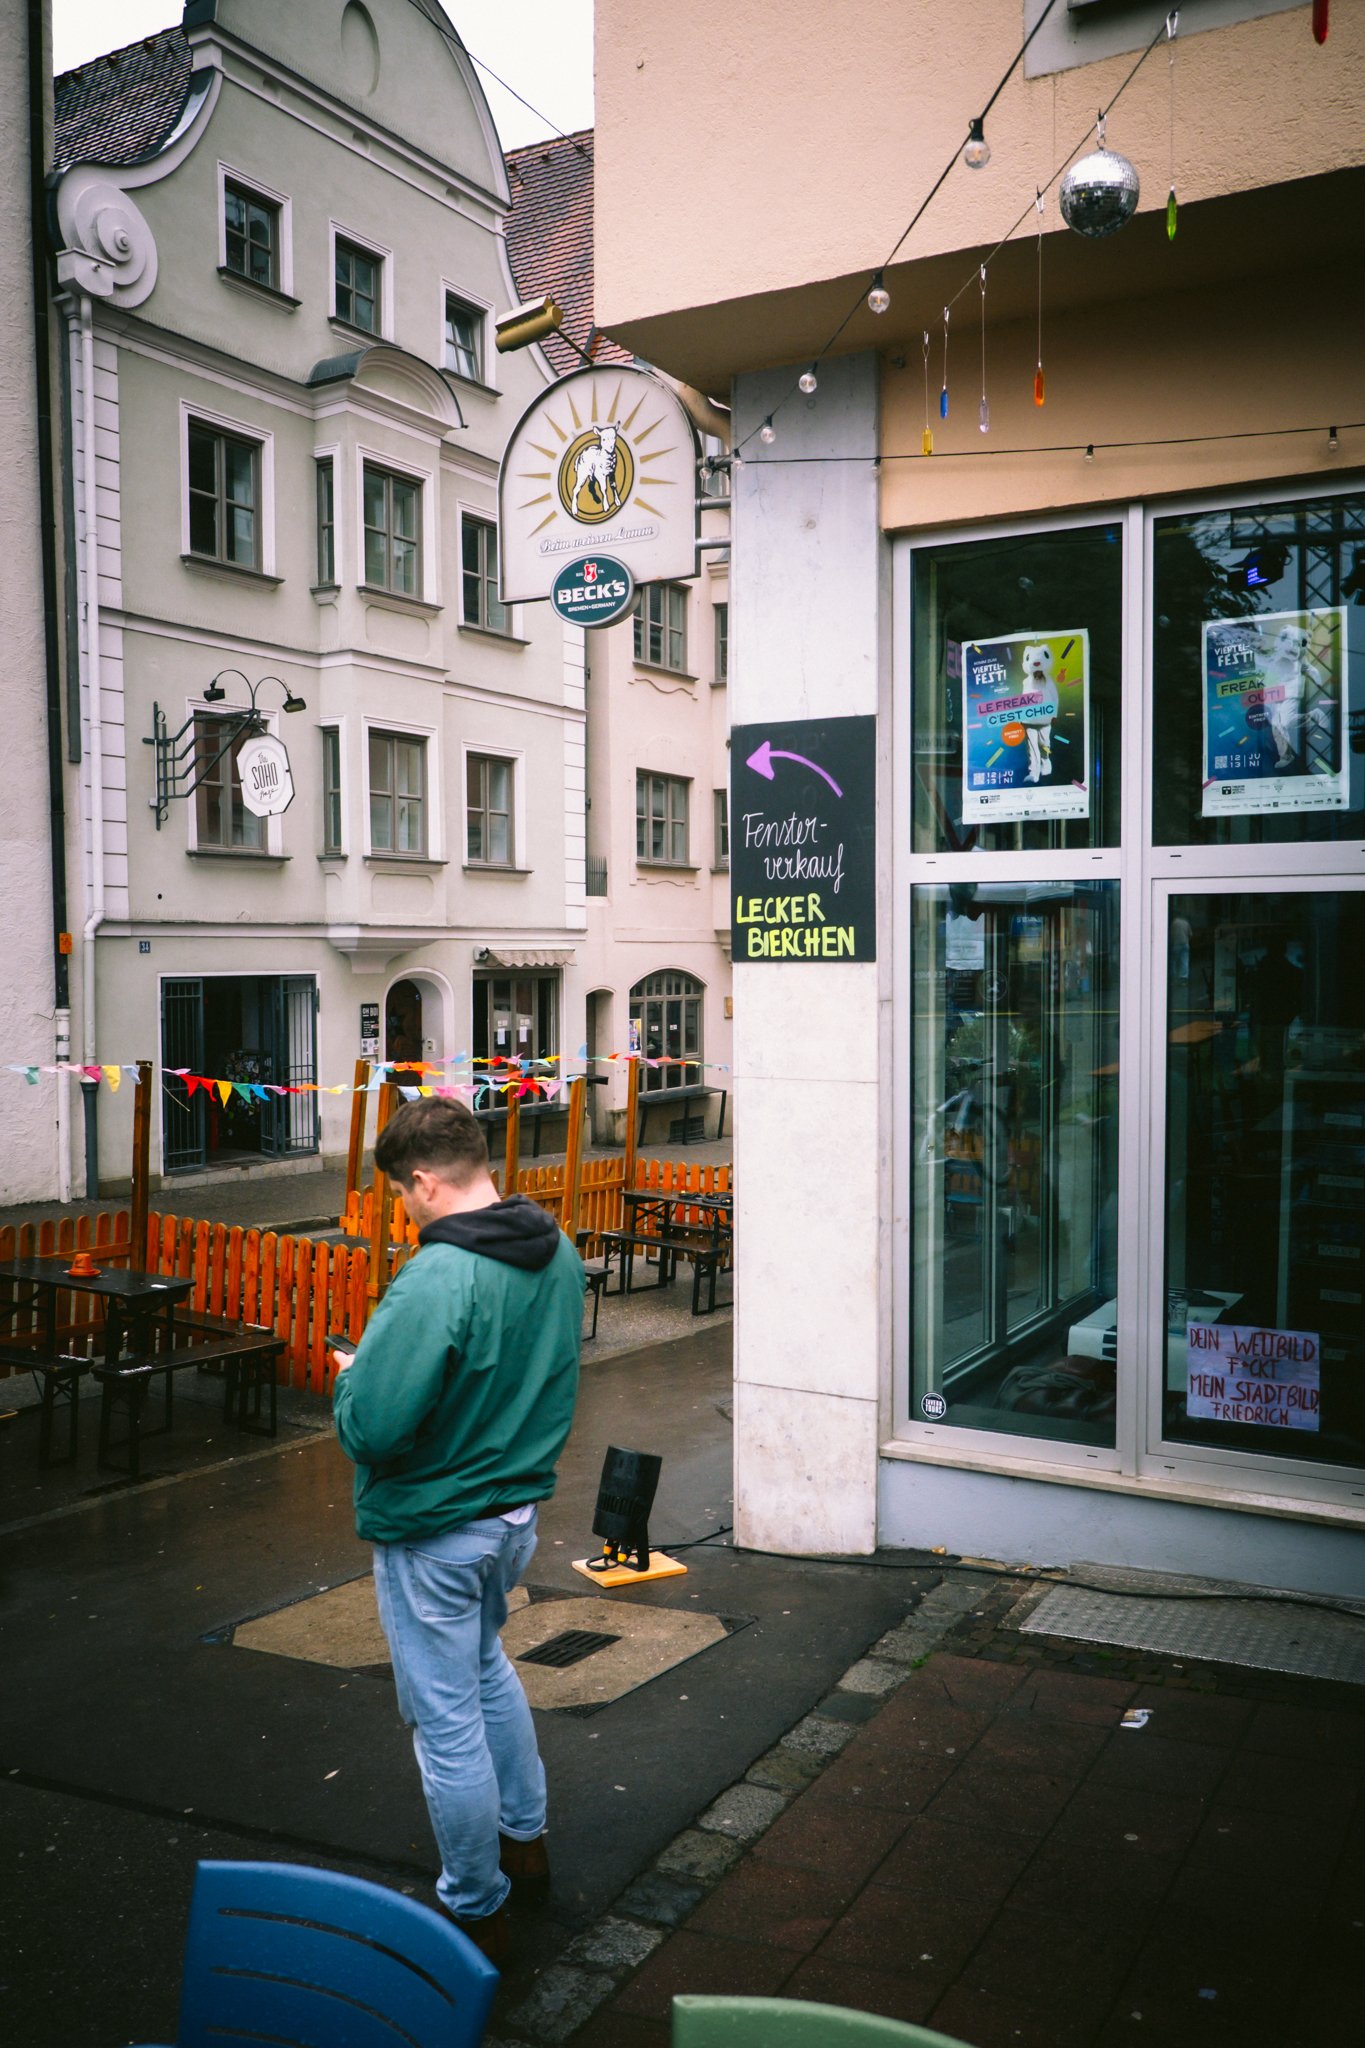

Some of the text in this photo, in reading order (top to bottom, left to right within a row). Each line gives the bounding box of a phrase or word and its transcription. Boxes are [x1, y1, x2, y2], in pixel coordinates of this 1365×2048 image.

[557, 579, 626, 604] BECK'S
[978, 702, 993, 714] LE
[988, 704, 1054, 725] C'EST CHIC
[251, 762, 278, 790] SOHO
[742, 811, 827, 848] Fenster-
[763, 842, 845, 894] verkauf
[736, 893, 826, 924] LECKER
[747, 925, 855, 958] BIERCHEN
[1190, 1328, 1220, 1351] DEIN
[1233, 1330, 1316, 1362] WELTBILD
[1190, 1374, 1225, 1400] MEIN
